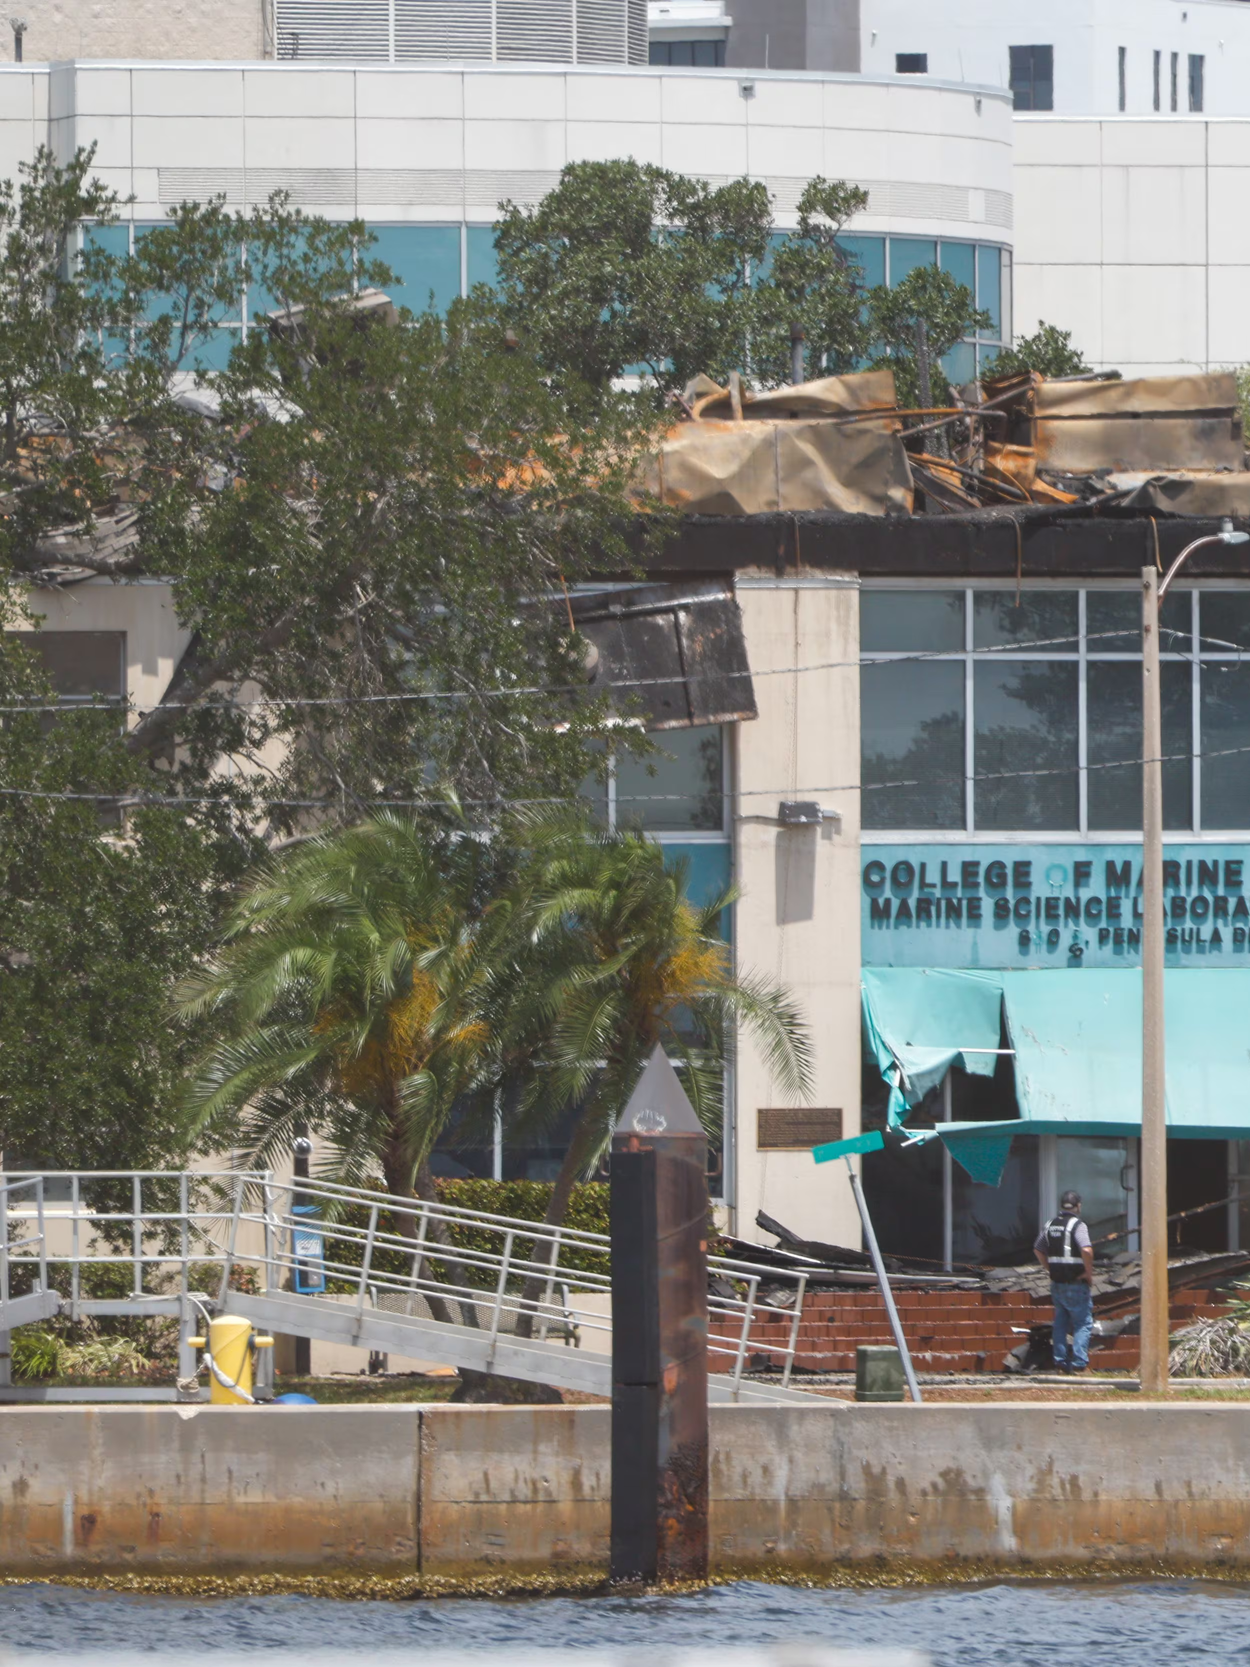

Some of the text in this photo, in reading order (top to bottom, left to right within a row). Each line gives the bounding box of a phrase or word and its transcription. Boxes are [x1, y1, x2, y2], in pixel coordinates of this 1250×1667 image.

[863, 860, 1032, 888] COLLEGE
[870, 897, 983, 919] MARINE
[993, 896, 1122, 918] SCIENCE
[1098, 927, 1224, 944] PENSULA
